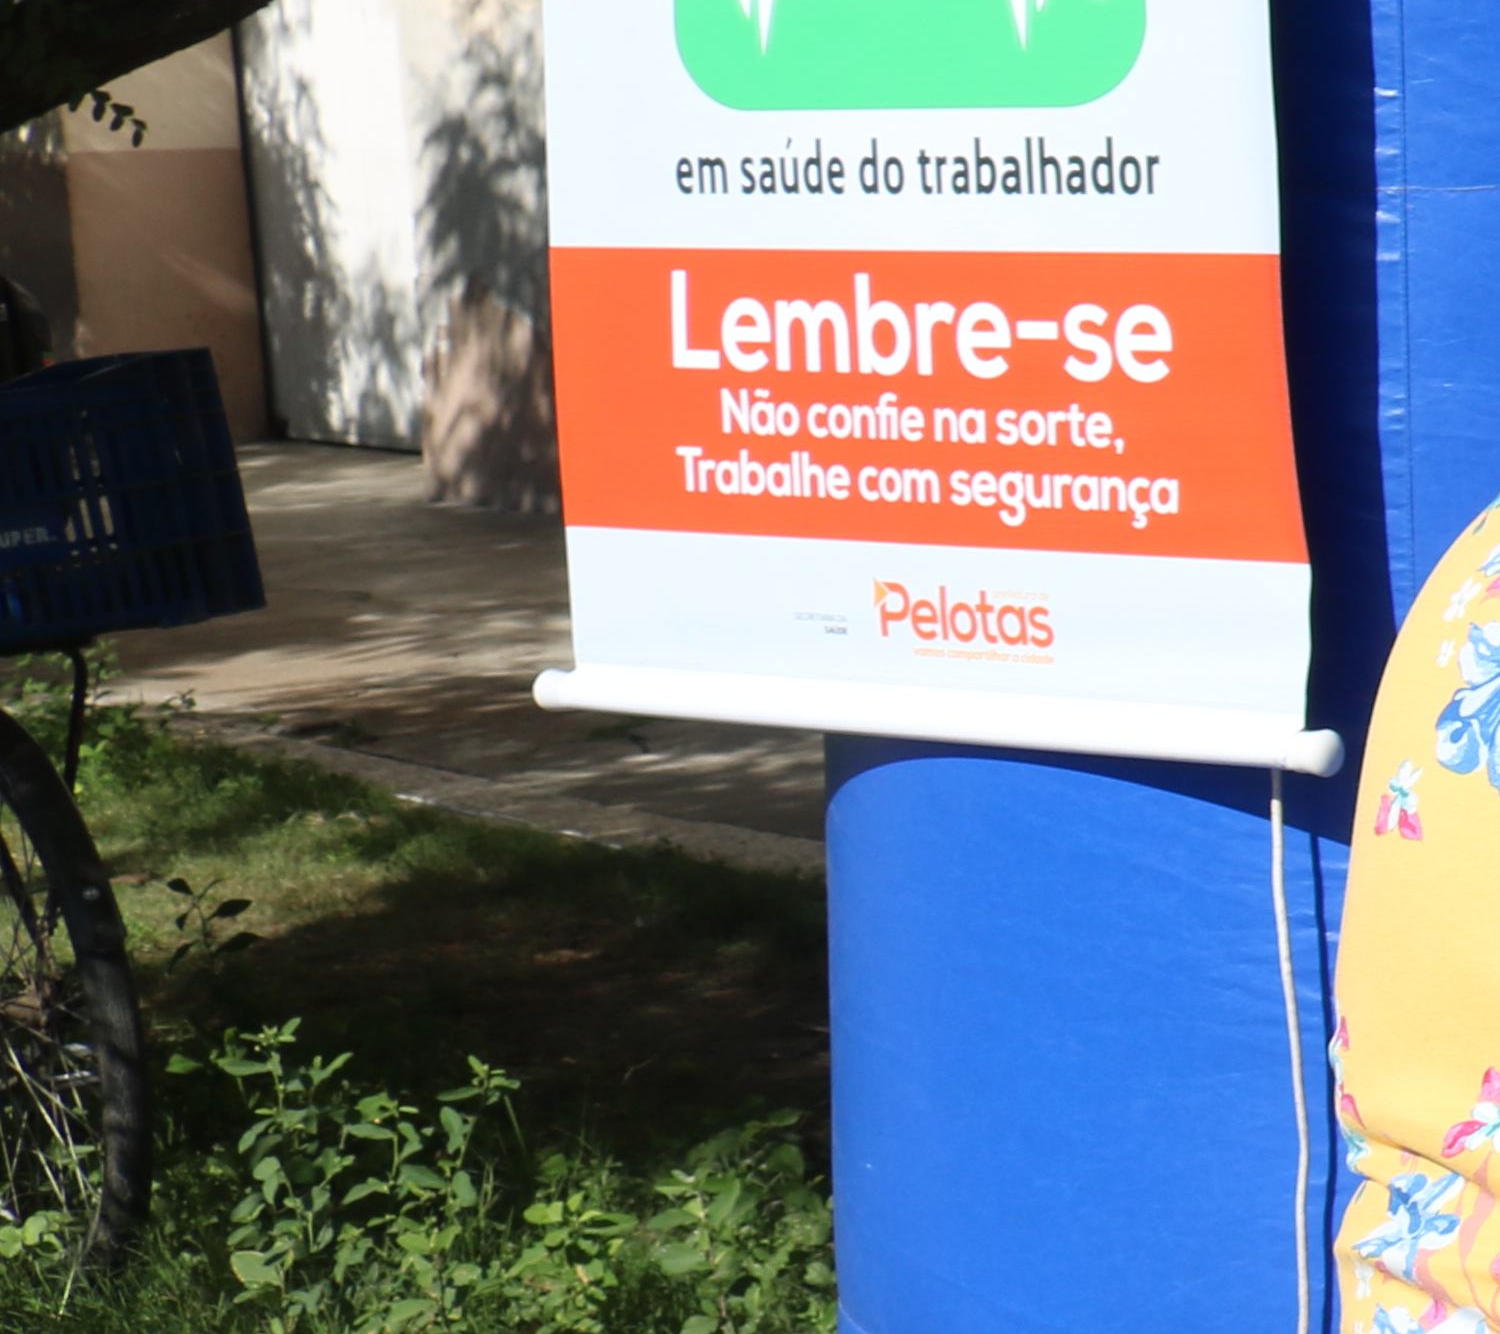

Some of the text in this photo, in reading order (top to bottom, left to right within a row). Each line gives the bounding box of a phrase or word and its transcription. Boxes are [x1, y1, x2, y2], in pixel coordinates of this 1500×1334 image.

[675, 136, 1161, 195] em saúde do trabalhador
[670, 269, 1174, 383] Lembre-se
[720, 388, 1126, 454] Não confie na sorte,
[675, 446, 1180, 529] Trabalhe com segurança
[876, 579, 1055, 648] Pelotas
